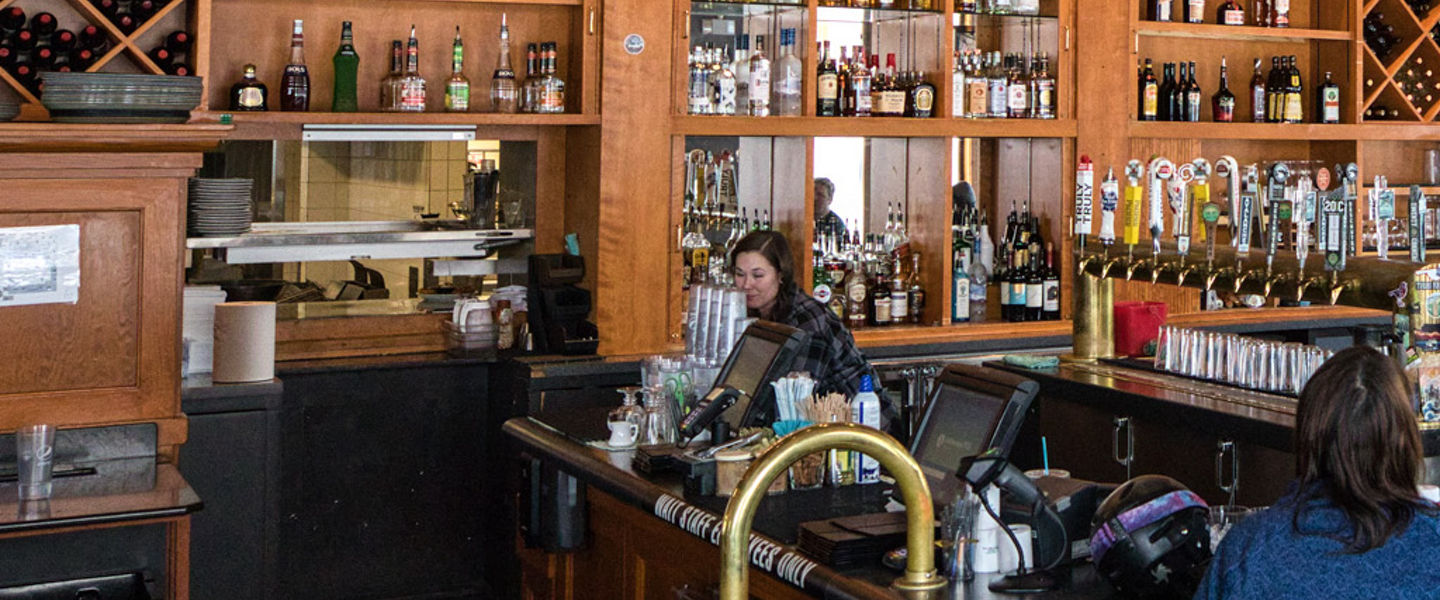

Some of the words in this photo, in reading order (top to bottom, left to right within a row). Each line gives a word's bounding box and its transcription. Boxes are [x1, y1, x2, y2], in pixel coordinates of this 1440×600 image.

[1083, 182, 1092, 225] TRULY
[654, 493, 684, 524] WAIT
[679, 505, 717, 538] STAFF
[777, 552, 818, 588] ONLY
